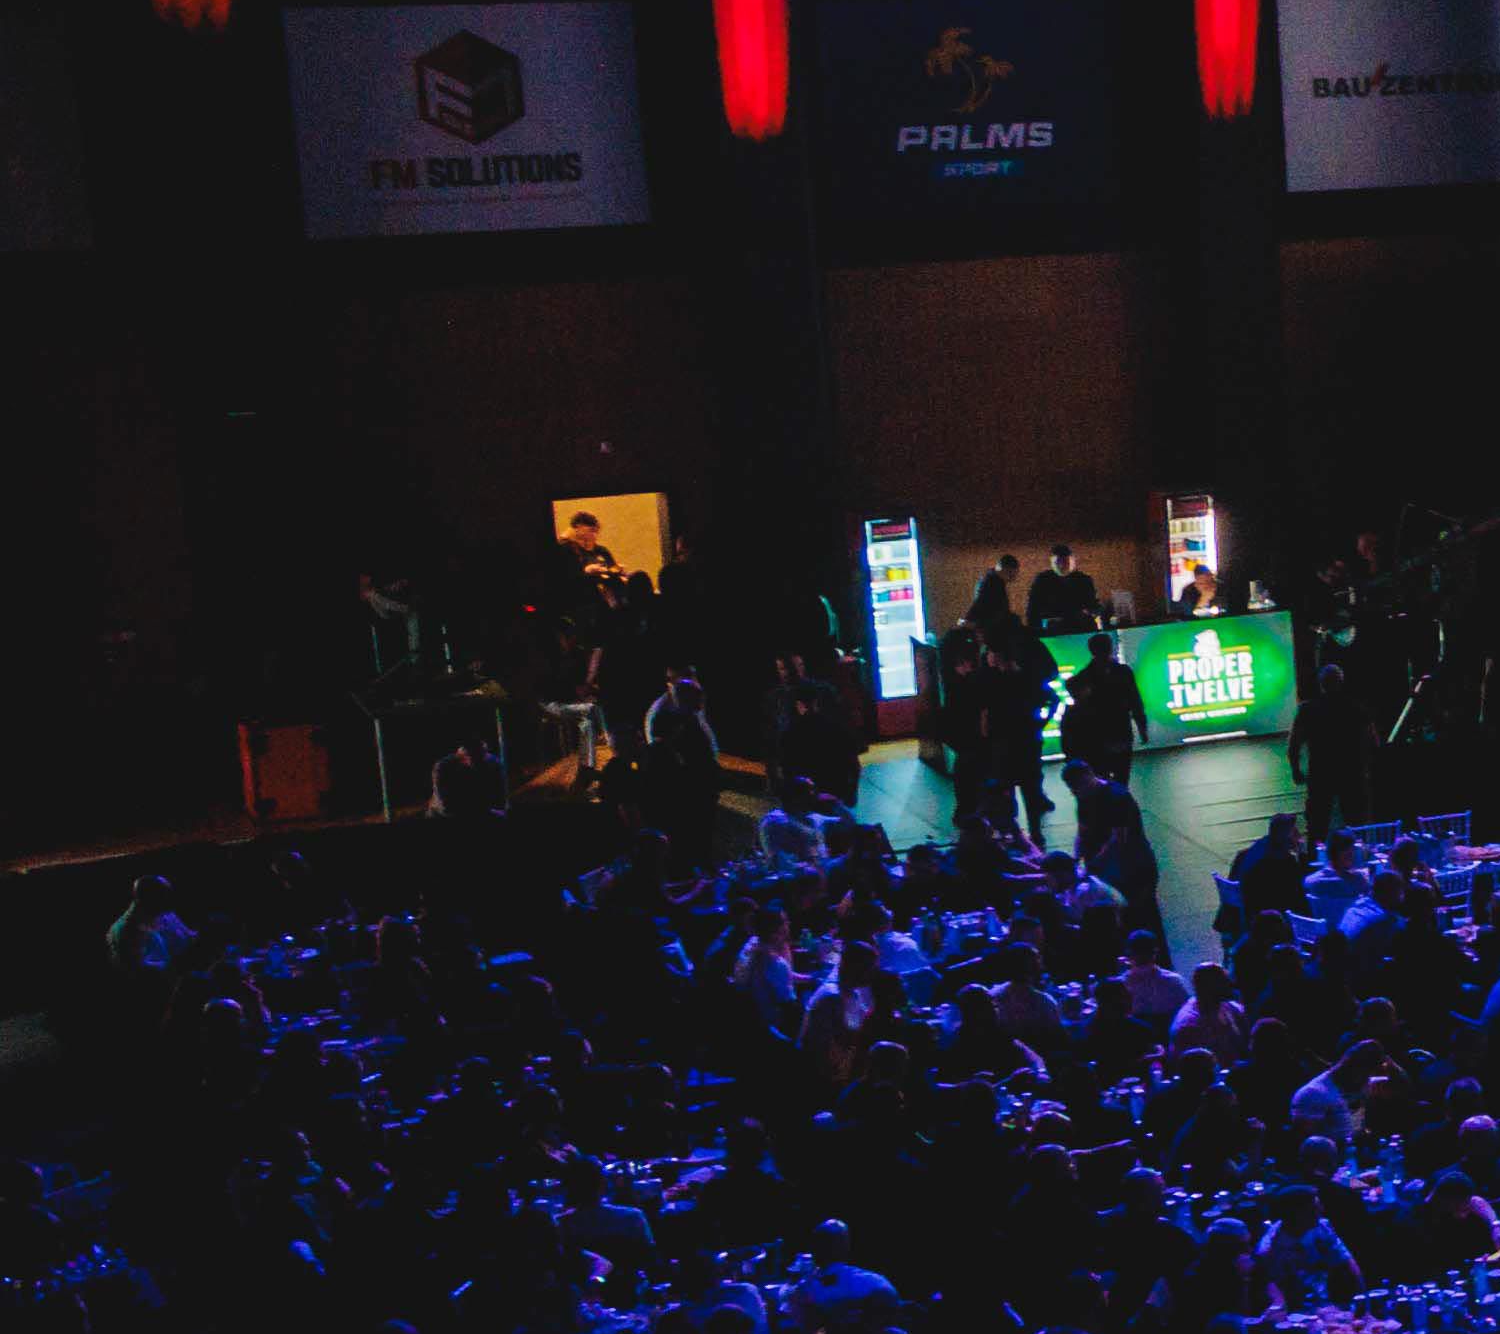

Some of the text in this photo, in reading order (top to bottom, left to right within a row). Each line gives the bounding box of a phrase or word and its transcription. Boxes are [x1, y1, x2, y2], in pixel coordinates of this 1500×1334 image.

[897, 121, 1054, 153] PALMS
[369, 152, 582, 189] FM SOLUTIONS
[1167, 651, 1254, 684] PROPER
